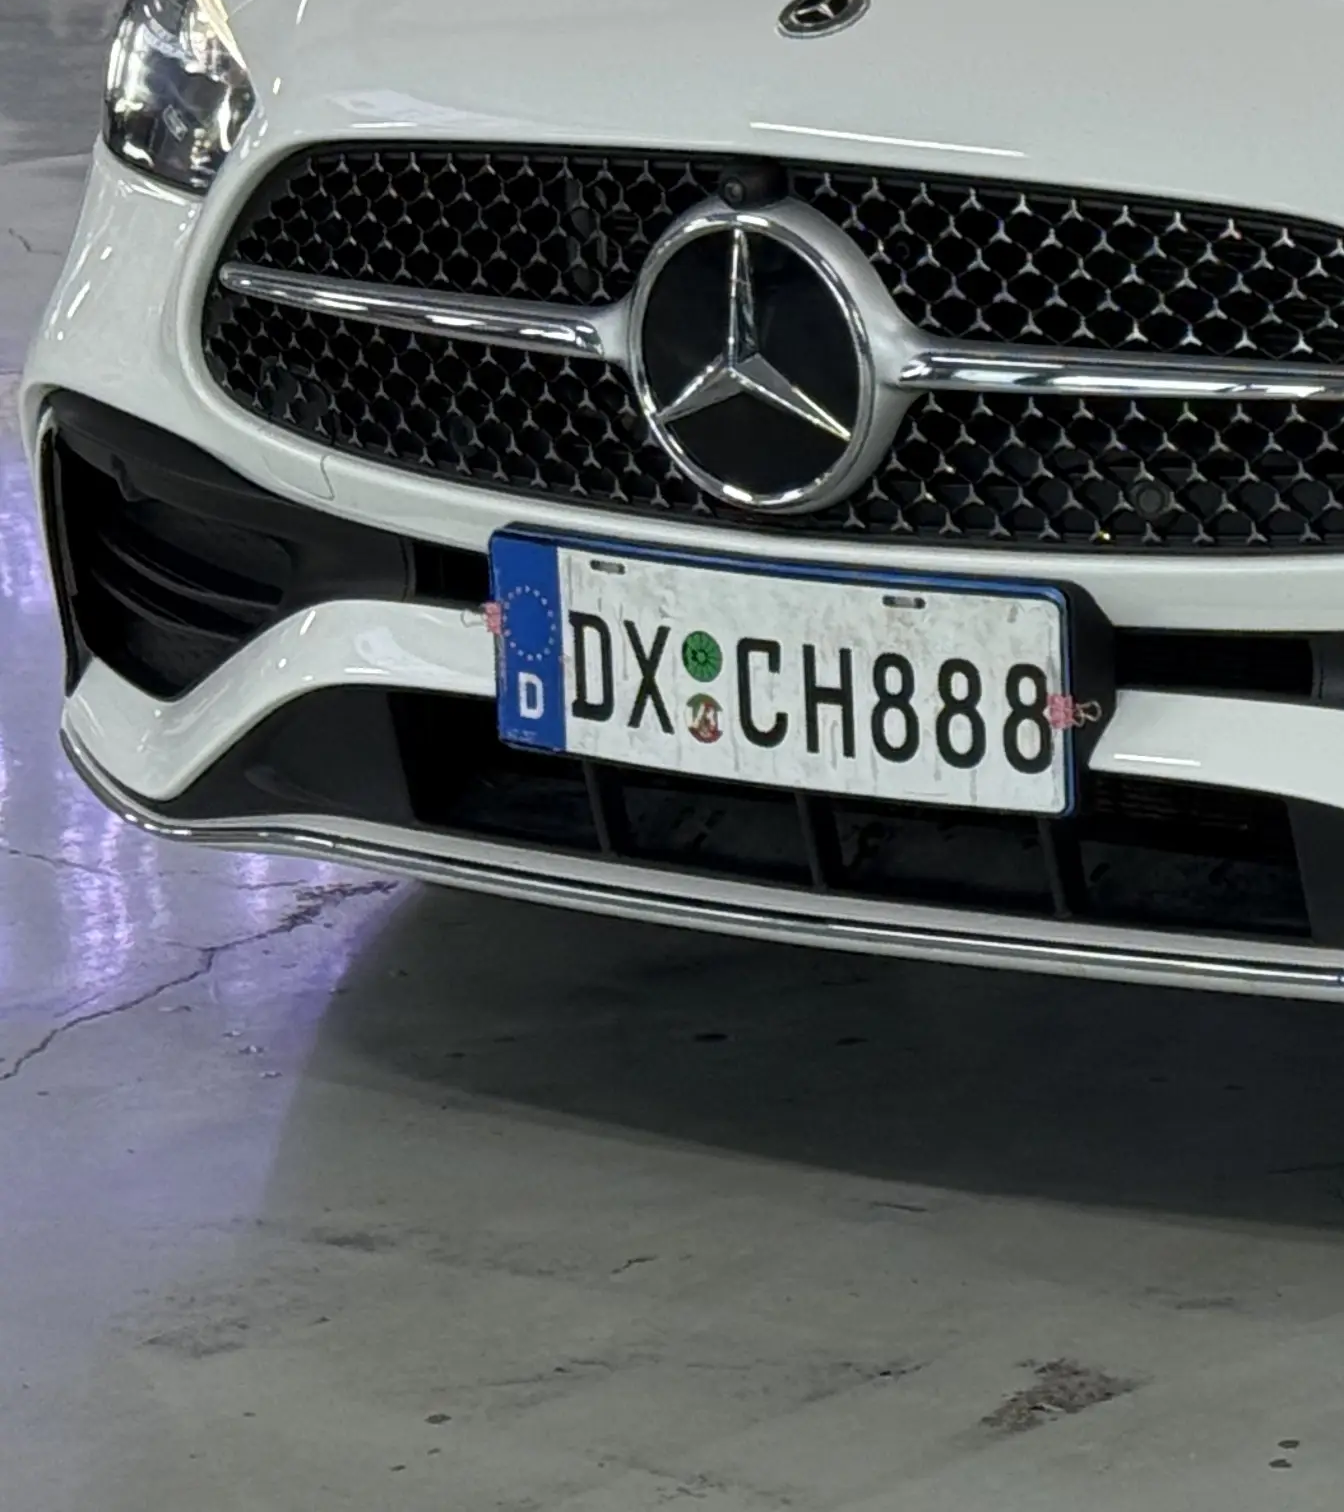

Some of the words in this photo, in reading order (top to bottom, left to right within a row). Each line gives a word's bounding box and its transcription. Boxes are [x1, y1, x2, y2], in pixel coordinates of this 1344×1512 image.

[518, 672, 544, 719] D
[568, 610, 675, 735] DX
[736, 636, 1053, 775] CH888
